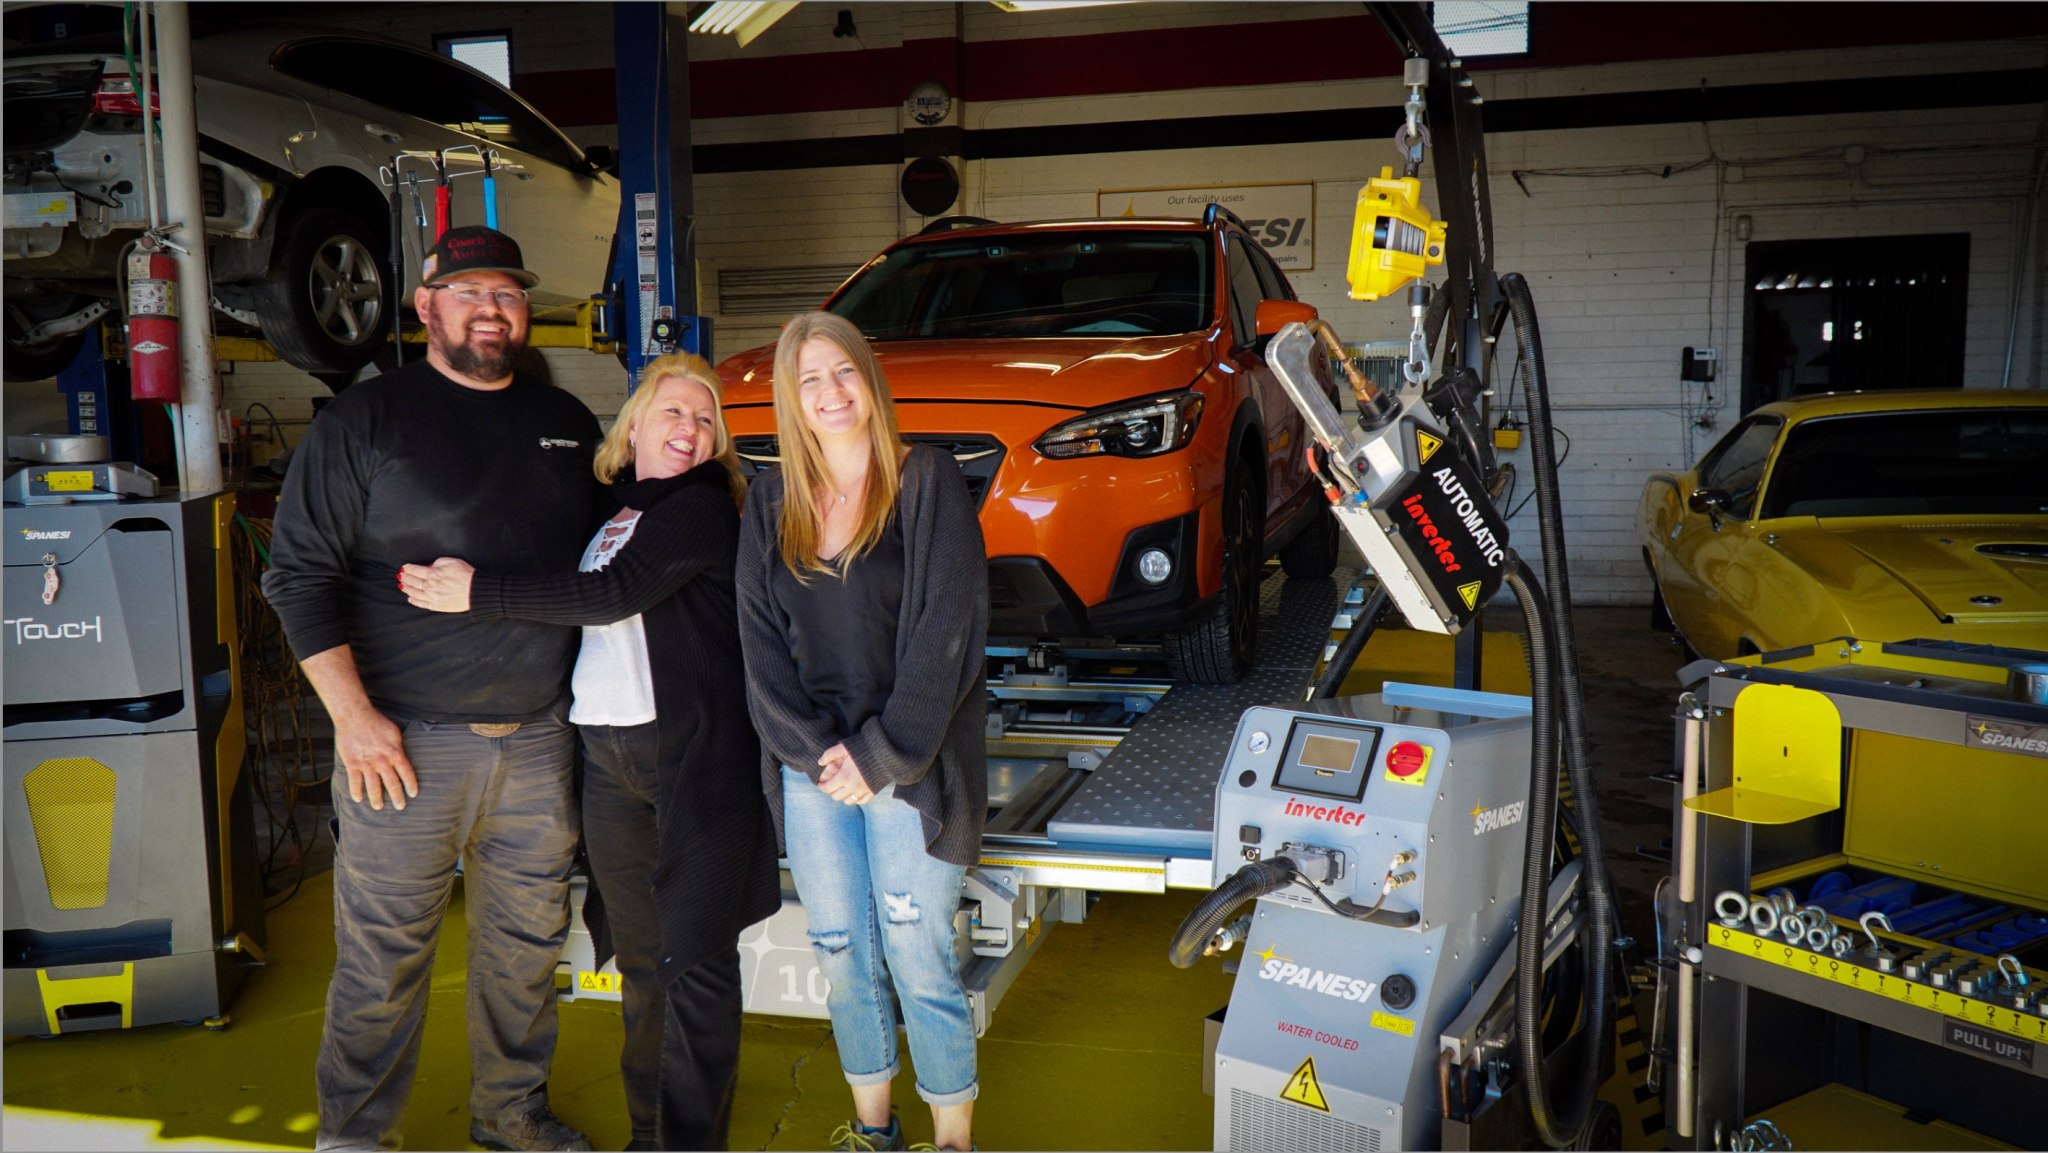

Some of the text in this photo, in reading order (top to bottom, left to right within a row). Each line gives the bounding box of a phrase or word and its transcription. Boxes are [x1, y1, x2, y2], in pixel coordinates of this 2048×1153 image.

[1167, 193, 1245, 206] Our facility uses
[1432, 467, 1504, 567] AUTOMATIC
[25, 530, 71, 540] SPANESI
[1402, 494, 1462, 573] inverter
[1284, 797, 1366, 827] inverter
[1474, 800, 1525, 836] SPANESI
[1259, 959, 1376, 1004] SPANESI
[1277, 1020, 1360, 1051] WATER COOLED
[1953, 1029, 1992, 1051] PULL
[1995, 1041, 2023, 1060] UP!
